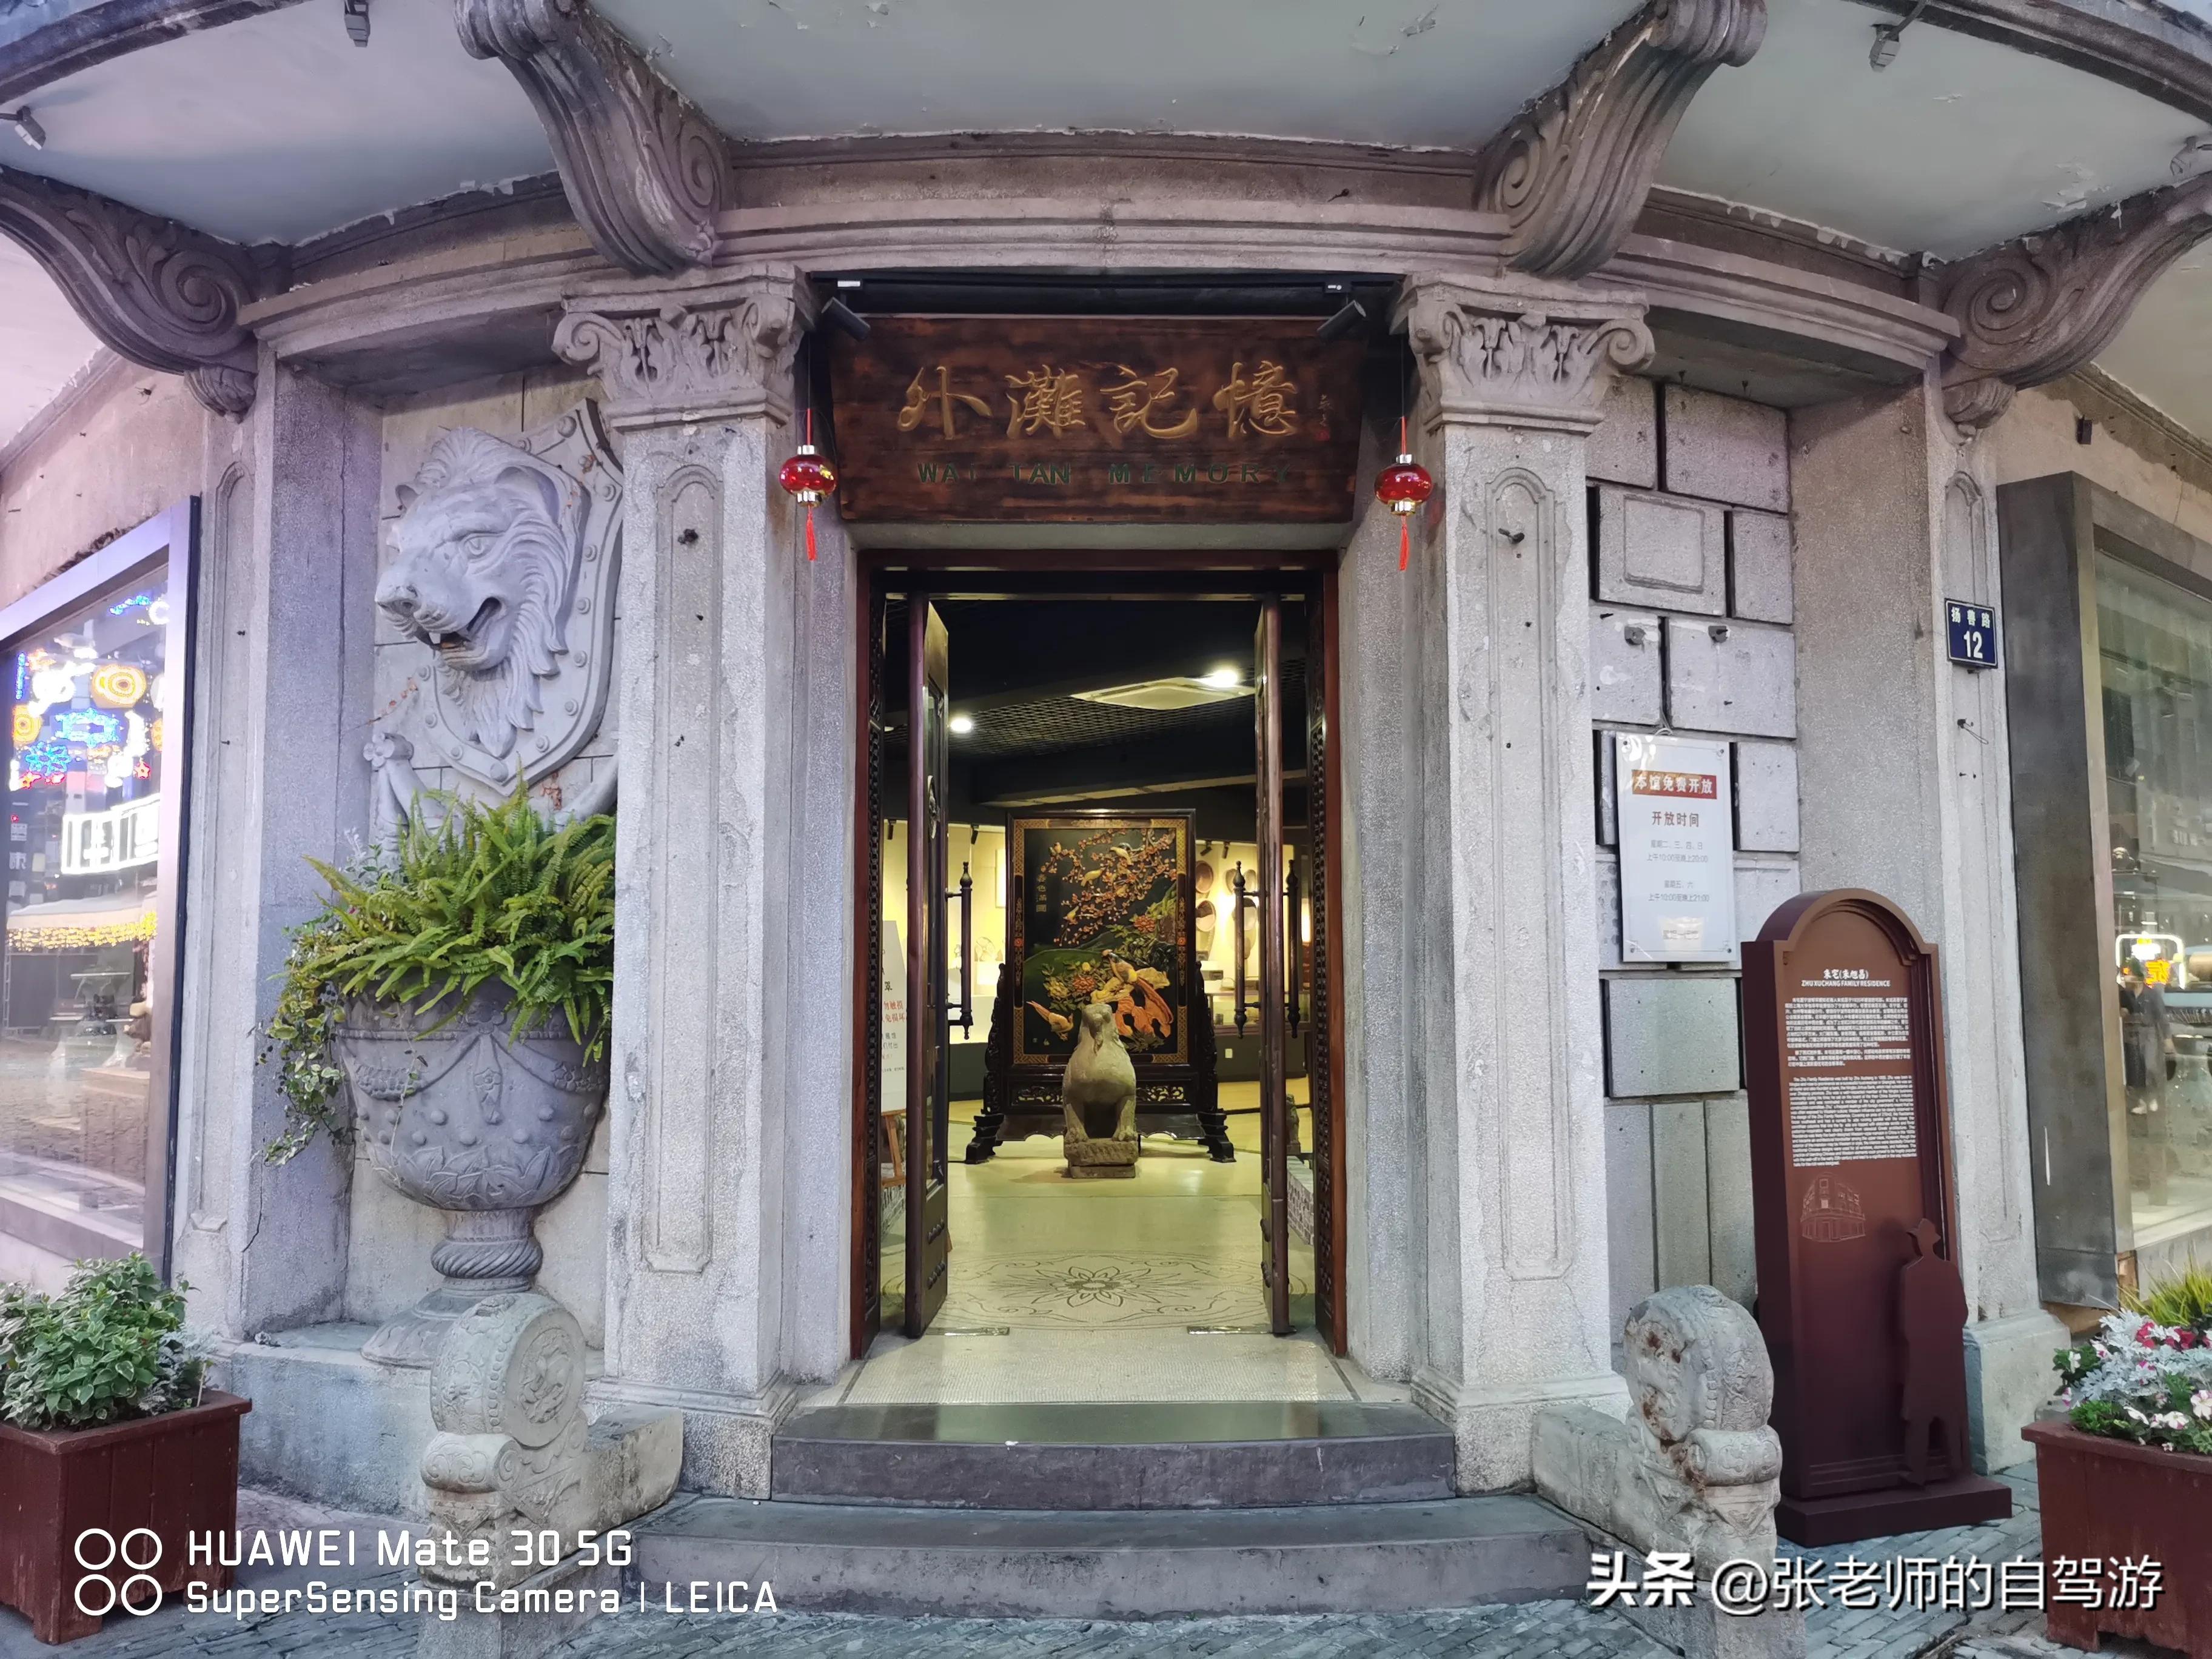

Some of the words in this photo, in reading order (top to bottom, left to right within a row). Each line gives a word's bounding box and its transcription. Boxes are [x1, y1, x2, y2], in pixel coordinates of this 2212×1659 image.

[897, 360, 1296, 441] 外灘記憶
[917, 462, 976, 484] WAI
[1010, 462, 1072, 485] TAN
[1108, 461, 1290, 485] MEMORY
[1963, 630, 1983, 659] 12
[1636, 774, 1714, 795] 本馆免费开放
[1651, 811, 1700, 828] 开放时间
